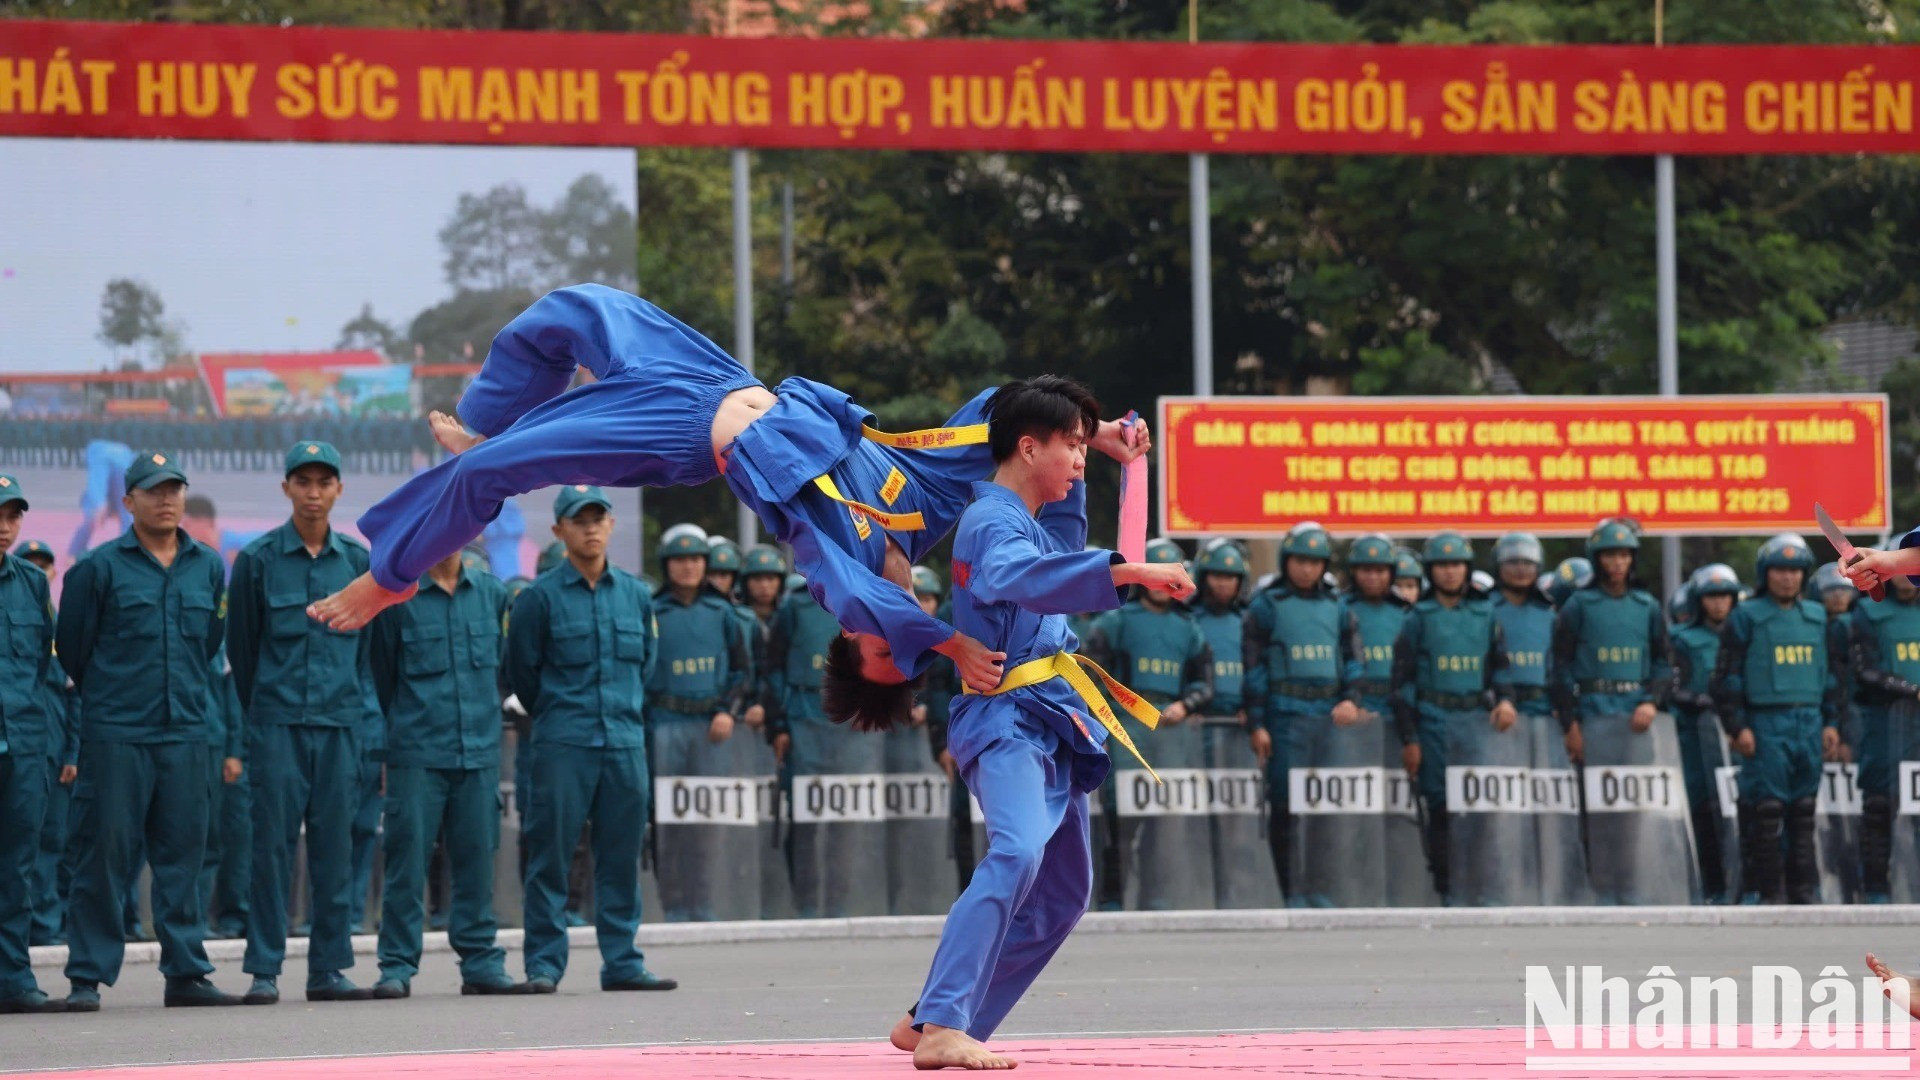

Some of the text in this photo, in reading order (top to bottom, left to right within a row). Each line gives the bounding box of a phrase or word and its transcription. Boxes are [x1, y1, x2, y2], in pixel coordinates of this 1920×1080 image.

[138, 61, 257, 118] HUY
[275, 53, 399, 120] SỨC
[418, 66, 600, 134] MẠNH
[616, 51, 771, 126] TỔNG
[789, 69, 912, 138] HỢP,
[930, 58, 1085, 129] HUẤN
[1104, 69, 1278, 143] LUYỆN
[1294, 63, 1424, 138] GIỎI,
[1441, 61, 1556, 133] SẴN
[1573, 70, 1727, 133] SÀNG
[1744, 65, 1912, 133] CHIẾN
[1567, 418, 1633, 446] SÁNG
[1694, 415, 1769, 447] QUYẾT
[1775, 415, 1856, 444] THẮNG
[1284, 455, 1343, 481] TÍCH
[1648, 453, 1714, 480] SÁNG
[1719, 455, 1767, 481] TẠO
[1725, 488, 1790, 513] 2025
[1775, 646, 1814, 665] DQTT
